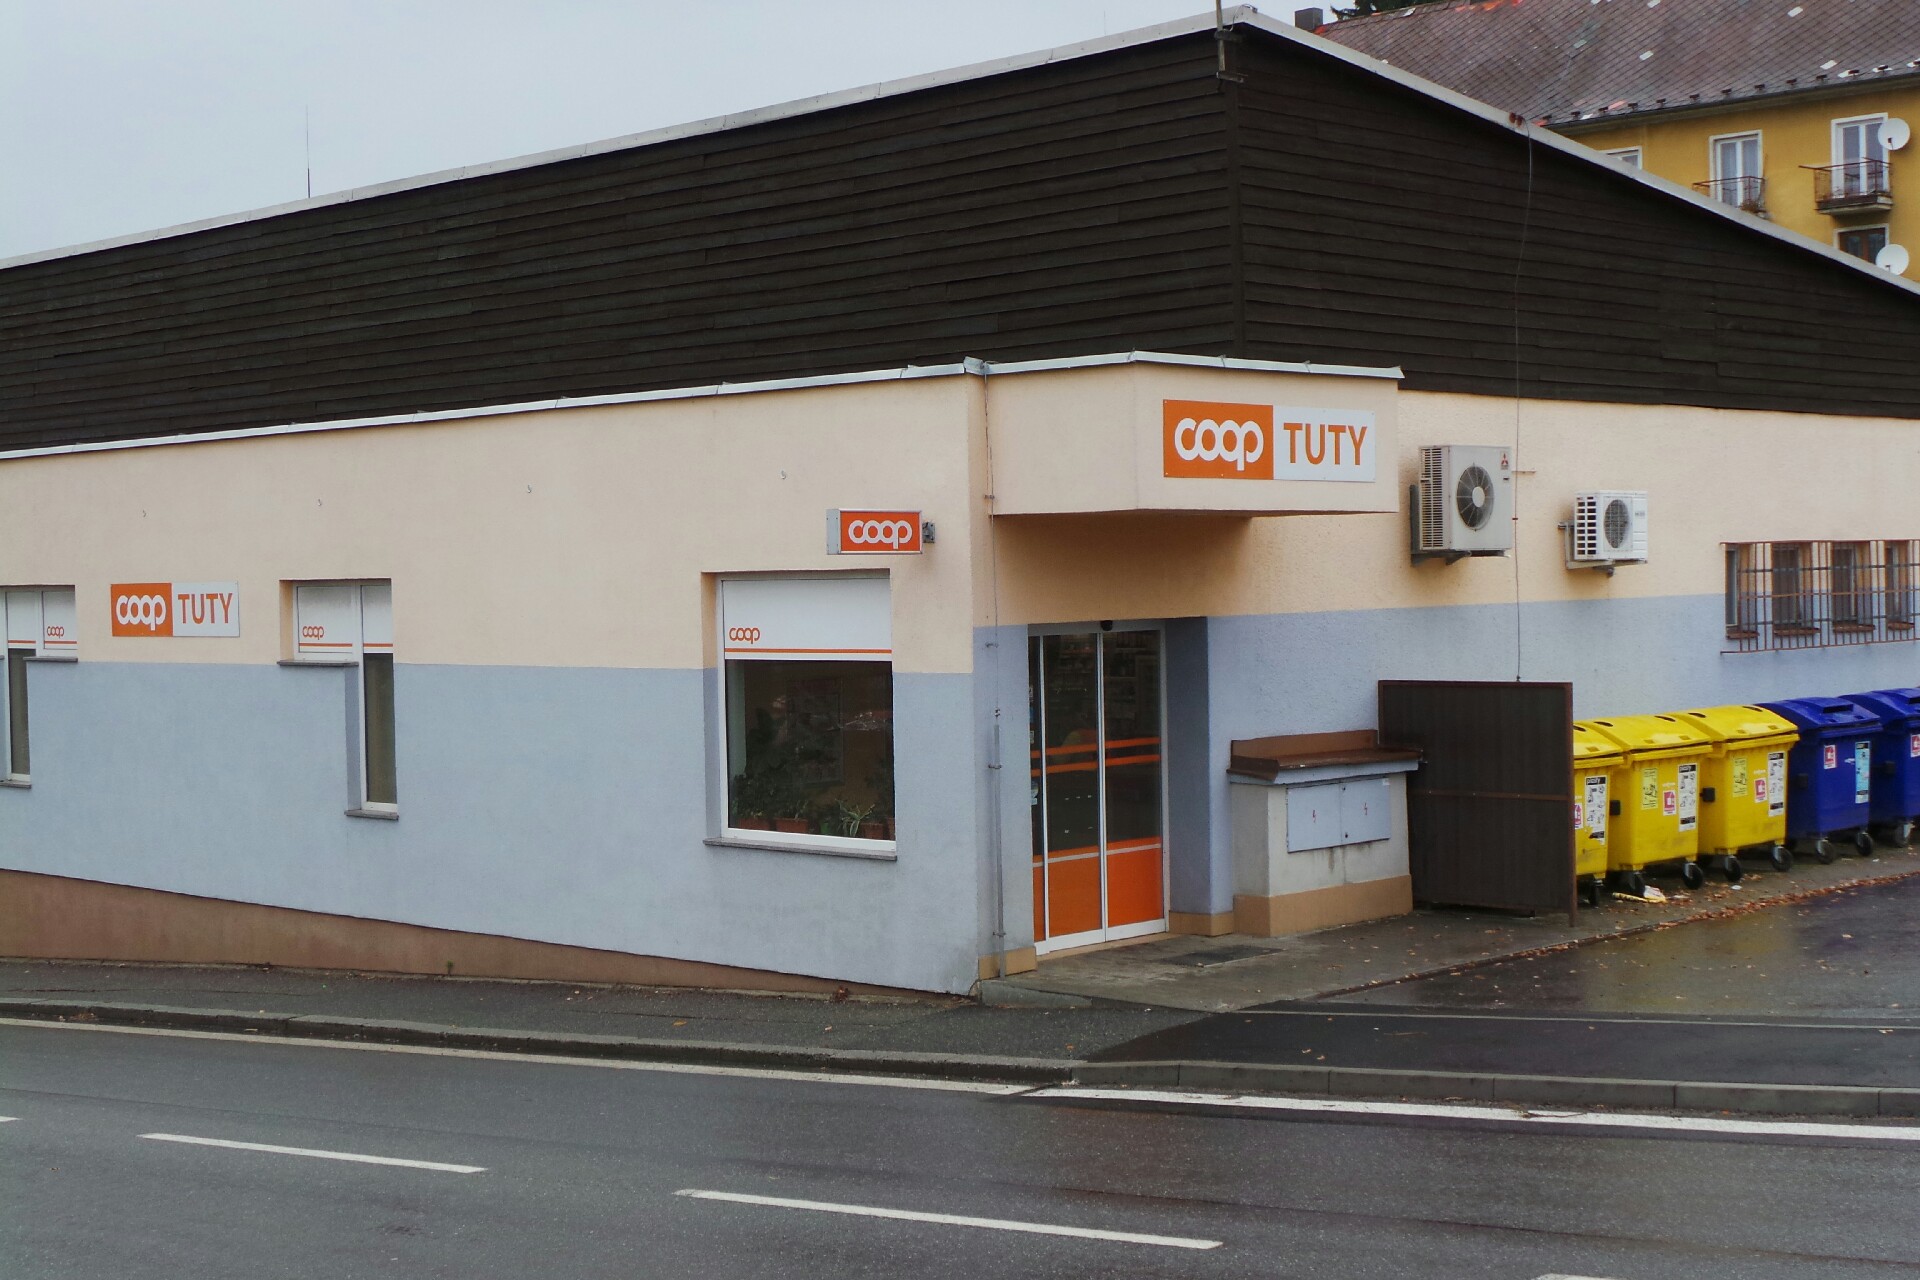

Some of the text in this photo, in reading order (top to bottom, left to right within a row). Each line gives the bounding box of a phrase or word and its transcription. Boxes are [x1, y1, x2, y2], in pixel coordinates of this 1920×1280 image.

[1174, 417, 1367, 471] coop TUTY
[848, 519, 912, 550] coop
[116, 593, 233, 631] coop TUTY
[47, 626, 64, 639] coop
[302, 626, 324, 640] coop
[729, 626, 761, 644] coop
